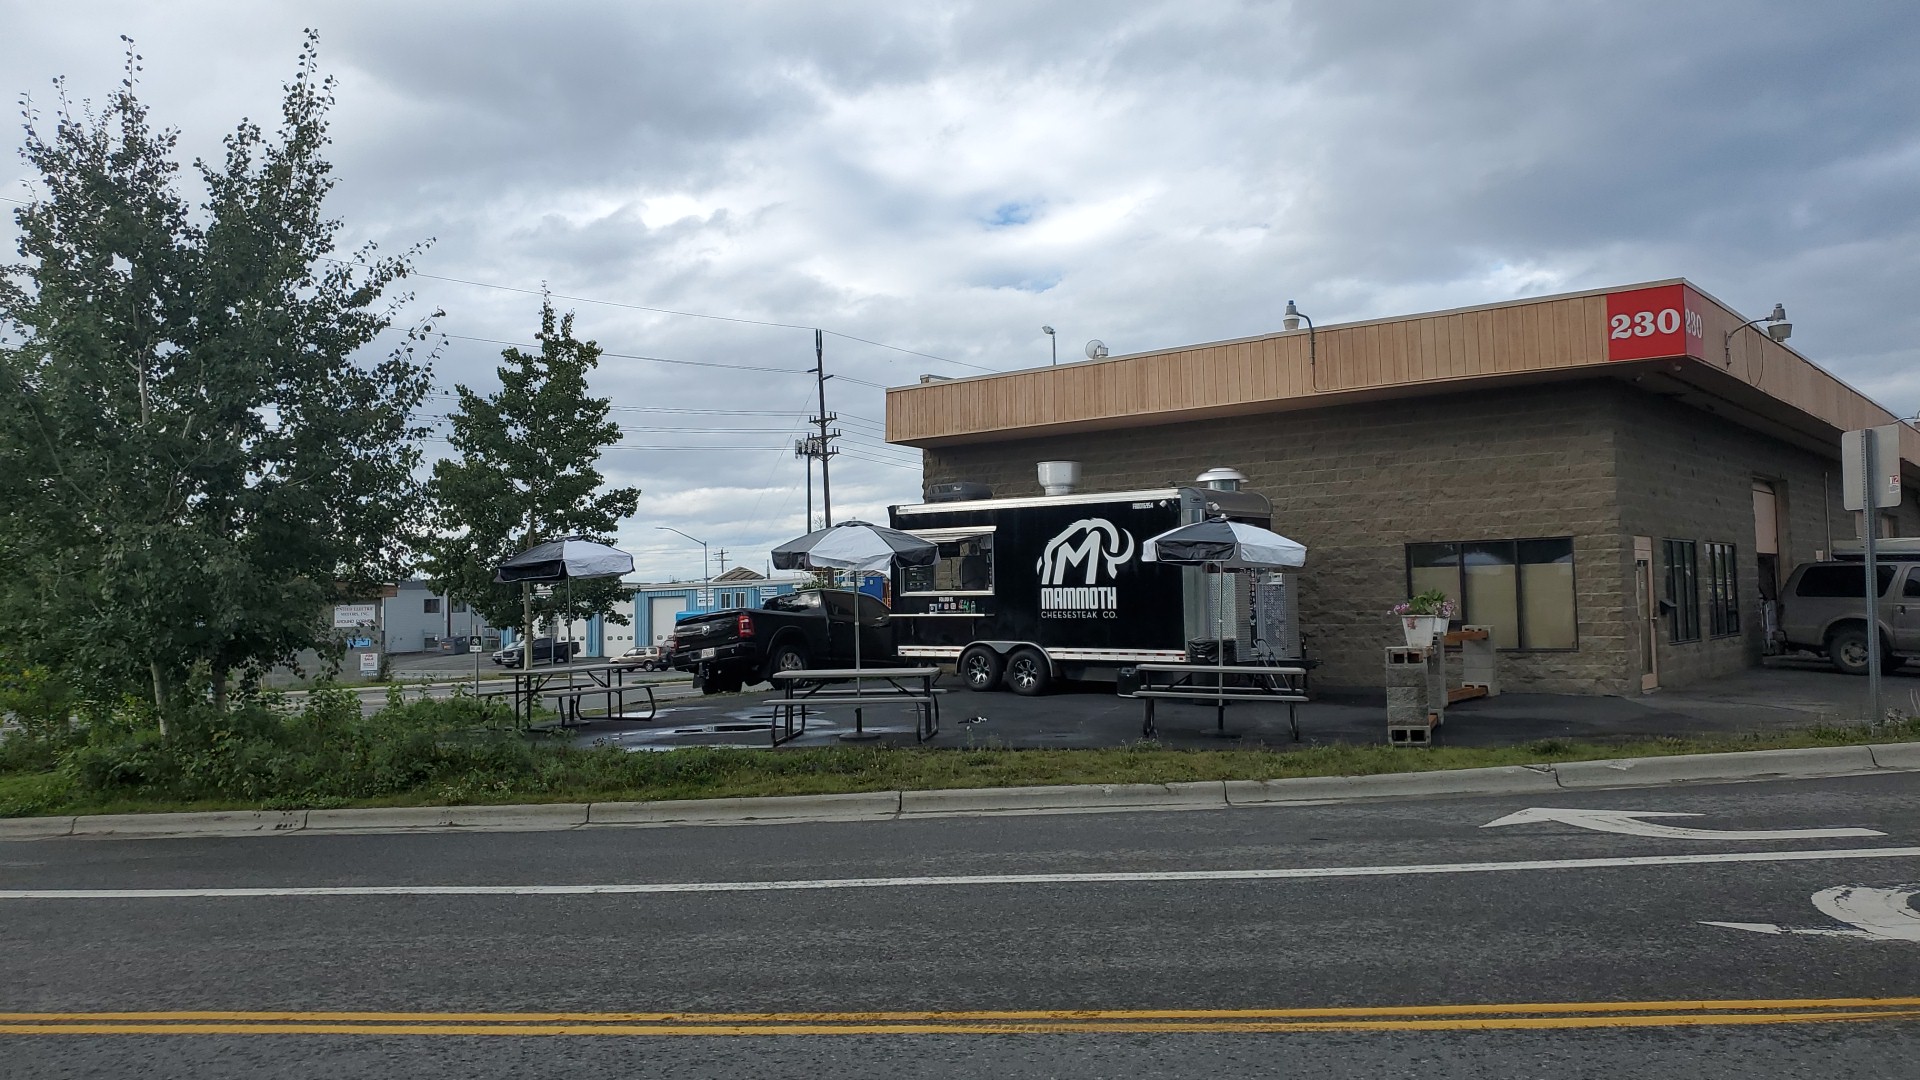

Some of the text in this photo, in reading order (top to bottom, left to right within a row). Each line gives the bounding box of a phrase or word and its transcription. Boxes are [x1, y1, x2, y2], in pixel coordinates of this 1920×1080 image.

[1611, 308, 1681, 340] 230
[1685, 308, 1703, 339] 230
[1041, 587, 1117, 610] MAMMOTH
[1041, 611, 1118, 619] CHEESESTEAK CO.
